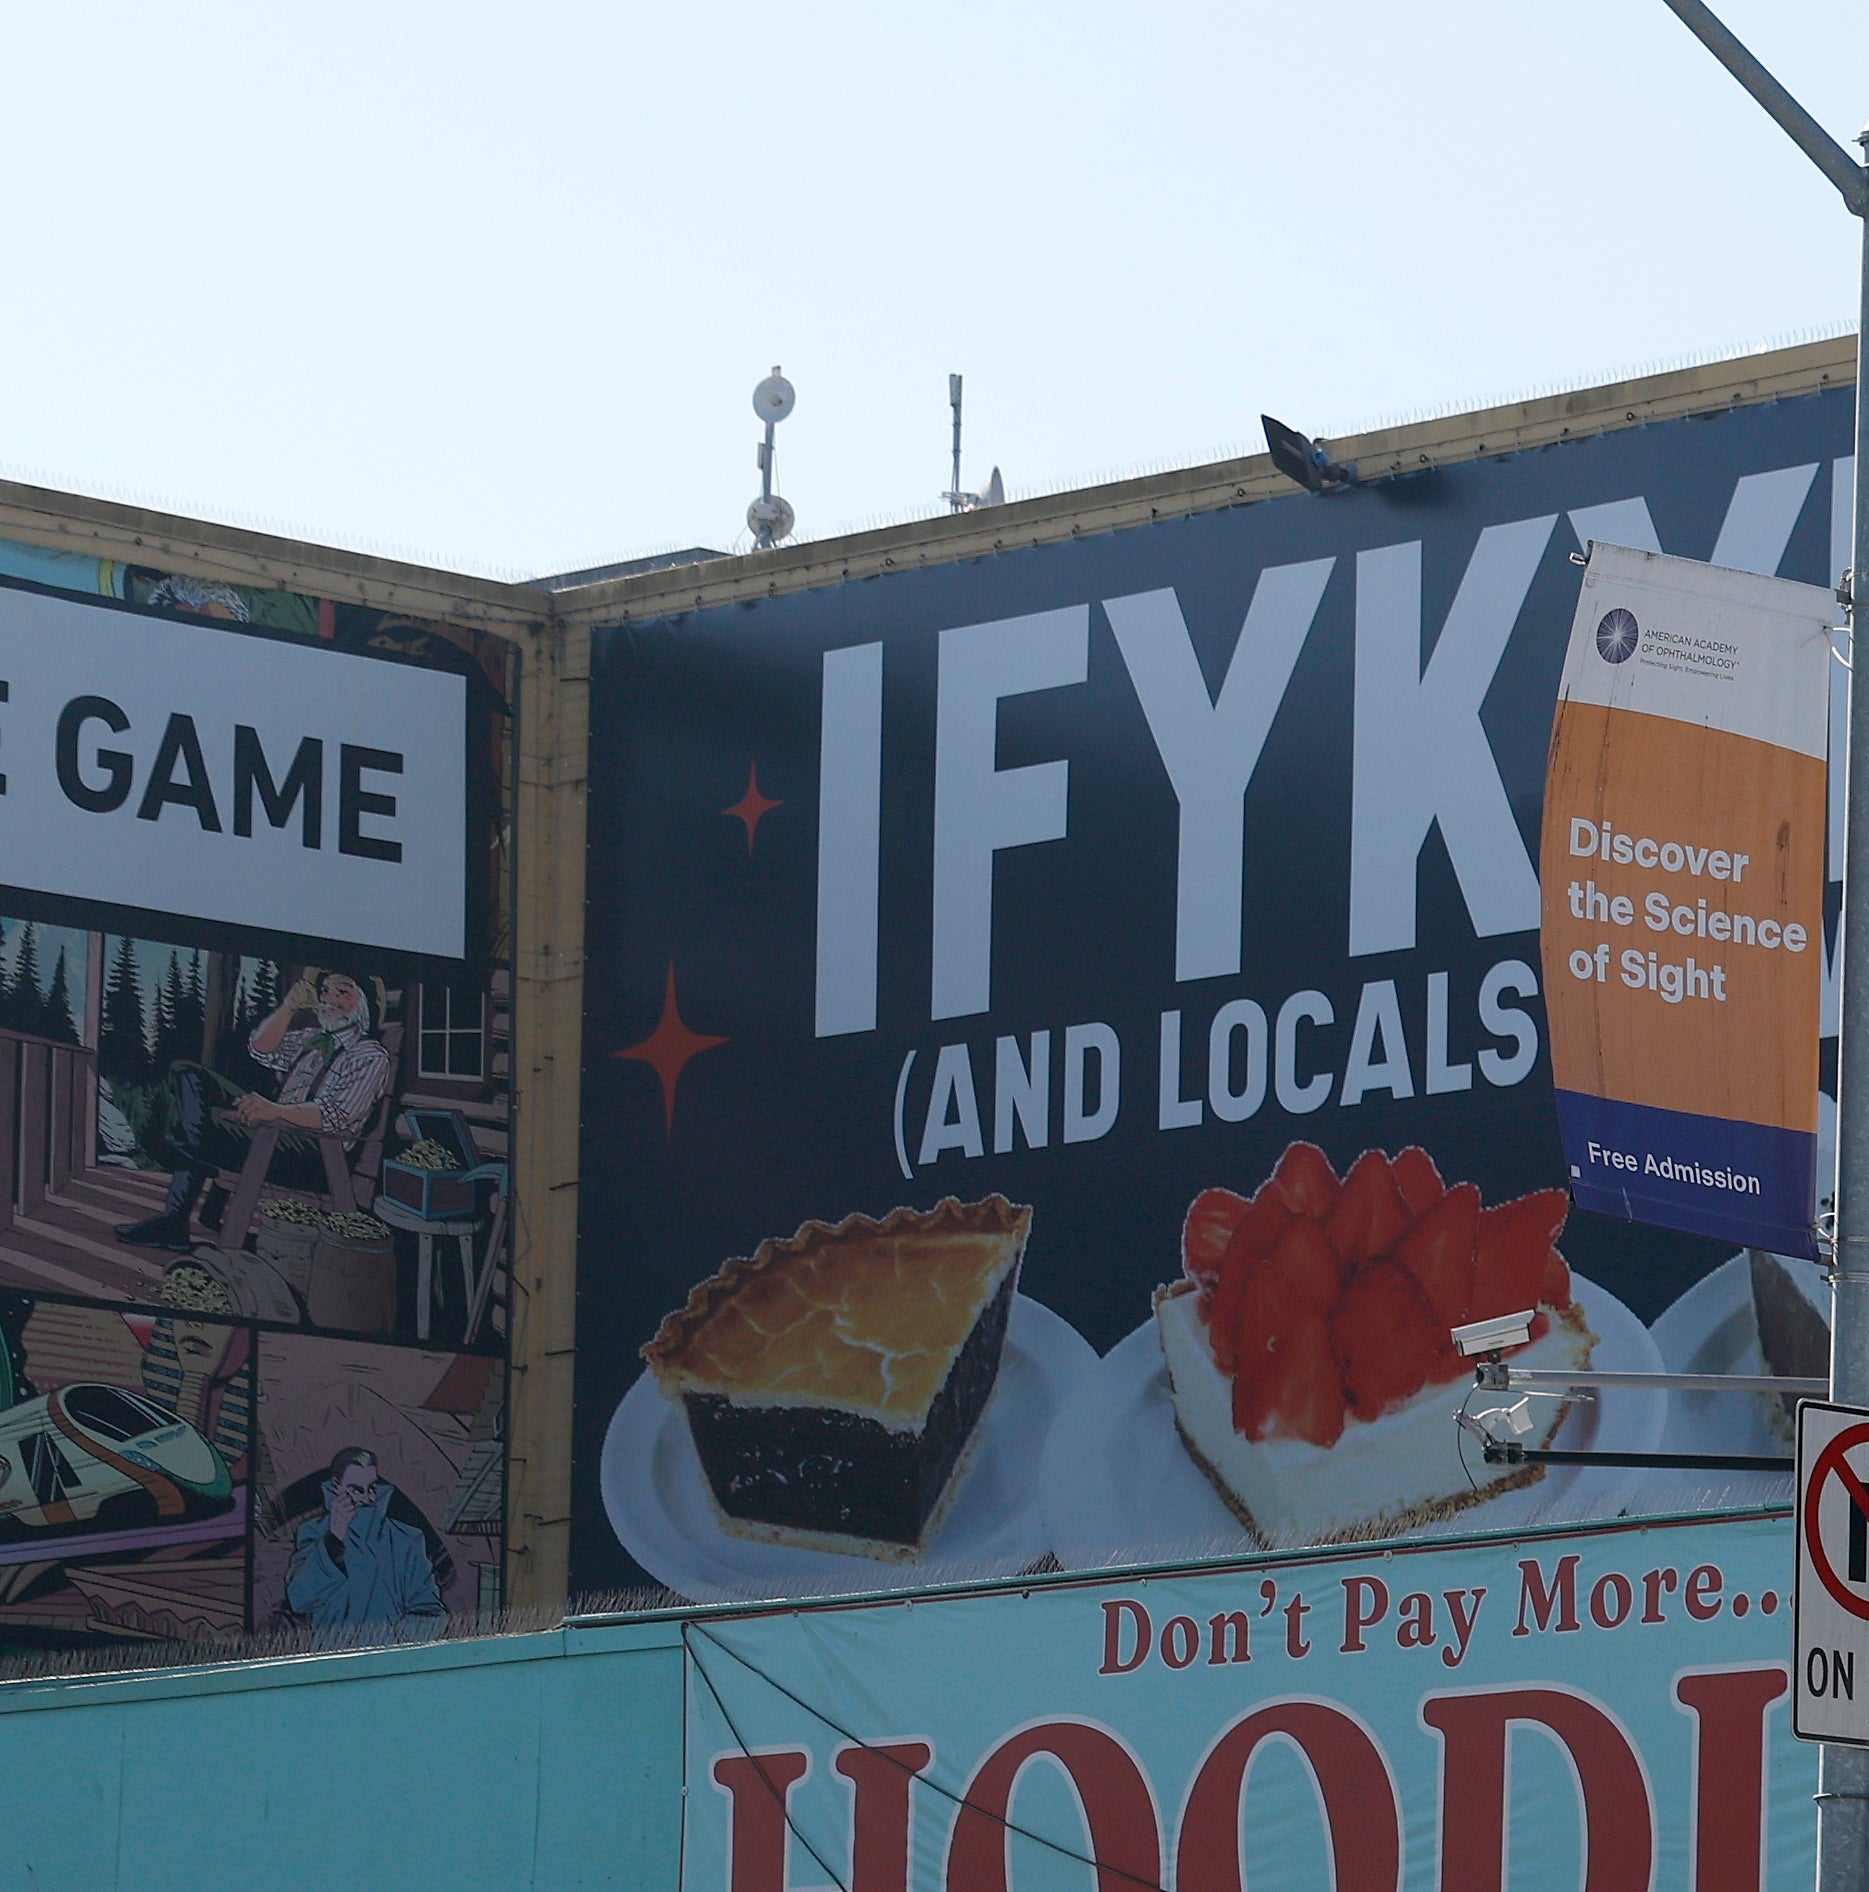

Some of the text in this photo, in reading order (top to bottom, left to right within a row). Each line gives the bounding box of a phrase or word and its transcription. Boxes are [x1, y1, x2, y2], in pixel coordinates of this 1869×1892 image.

[1641, 643, 1654, 654] OF
[1644, 629, 1740, 655] AMERICAN ACADEMY
[54, 694, 404, 864] GAME
[1568, 816, 1749, 885] Discover
[1568, 881, 1809, 954] the Science
[1568, 945, 1728, 1004] of Sight
[894, 957, 1542, 1180] (AND LOCALS
[1588, 1140, 1762, 1196] Free Admission
[1340, 1575, 1488, 1668] Pay
[1807, 1647, 1854, 1701] ON
